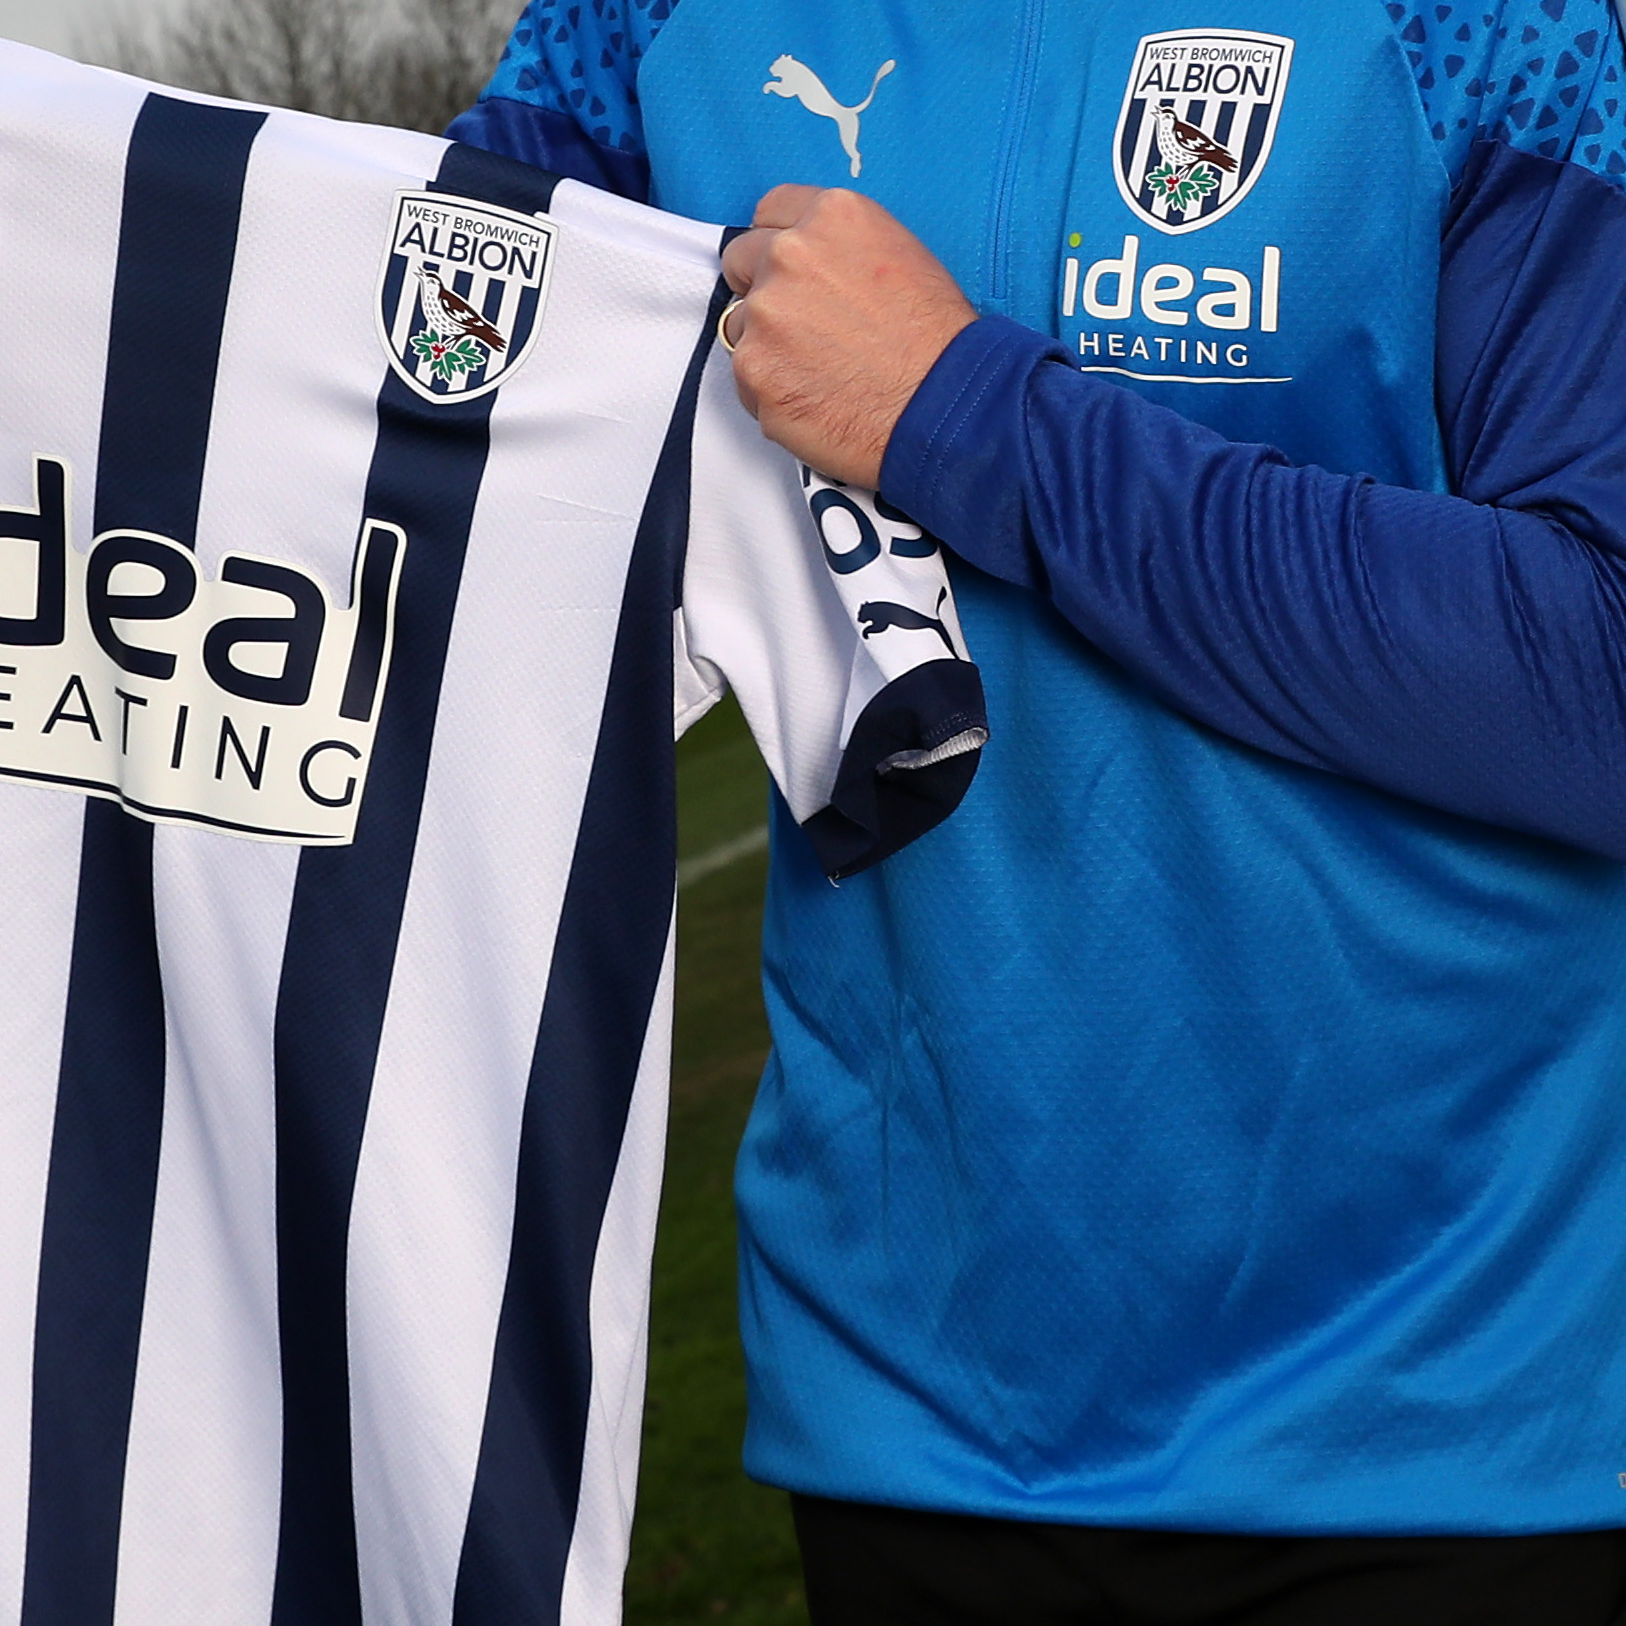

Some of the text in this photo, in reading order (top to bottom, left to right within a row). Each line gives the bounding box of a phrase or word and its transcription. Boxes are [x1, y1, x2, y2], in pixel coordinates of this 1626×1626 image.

[1149, 47, 1274, 64] WEST BROMWICH
[1140, 64, 1272, 96] ALBION
[406, 203, 541, 248] WEST BROMWICH
[399, 222, 538, 280] ALBION
[1062, 232, 1281, 333] ideal
[1079, 332, 1250, 367] HEATING
